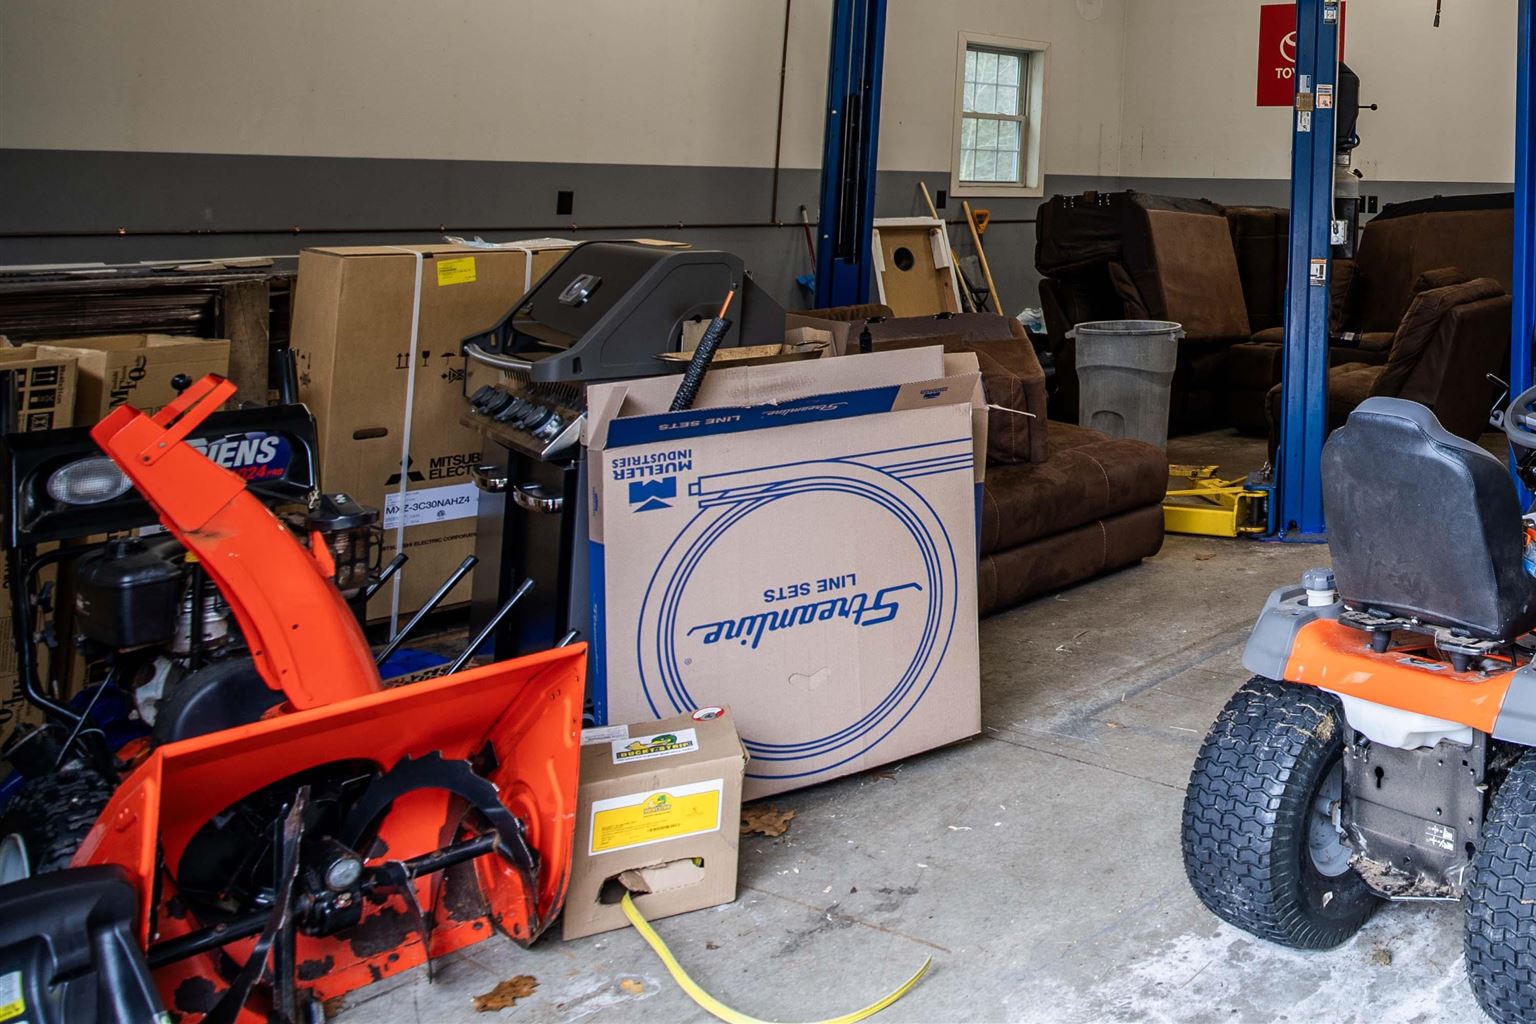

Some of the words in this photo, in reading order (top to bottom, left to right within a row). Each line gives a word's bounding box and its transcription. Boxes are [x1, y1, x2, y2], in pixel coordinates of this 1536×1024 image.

[1275, 67, 1296, 79] TO
[658, 420, 701, 431] SETS
[704, 414, 741, 426] LINE
[429, 452, 483, 469] MITSUB
[611, 449, 692, 469] INDUSTRIES
[613, 460, 693, 481] MUELLER
[763, 582, 811, 603] SETS
[816, 573, 856, 593] LINE
[687, 583, 923, 649] Streamline
